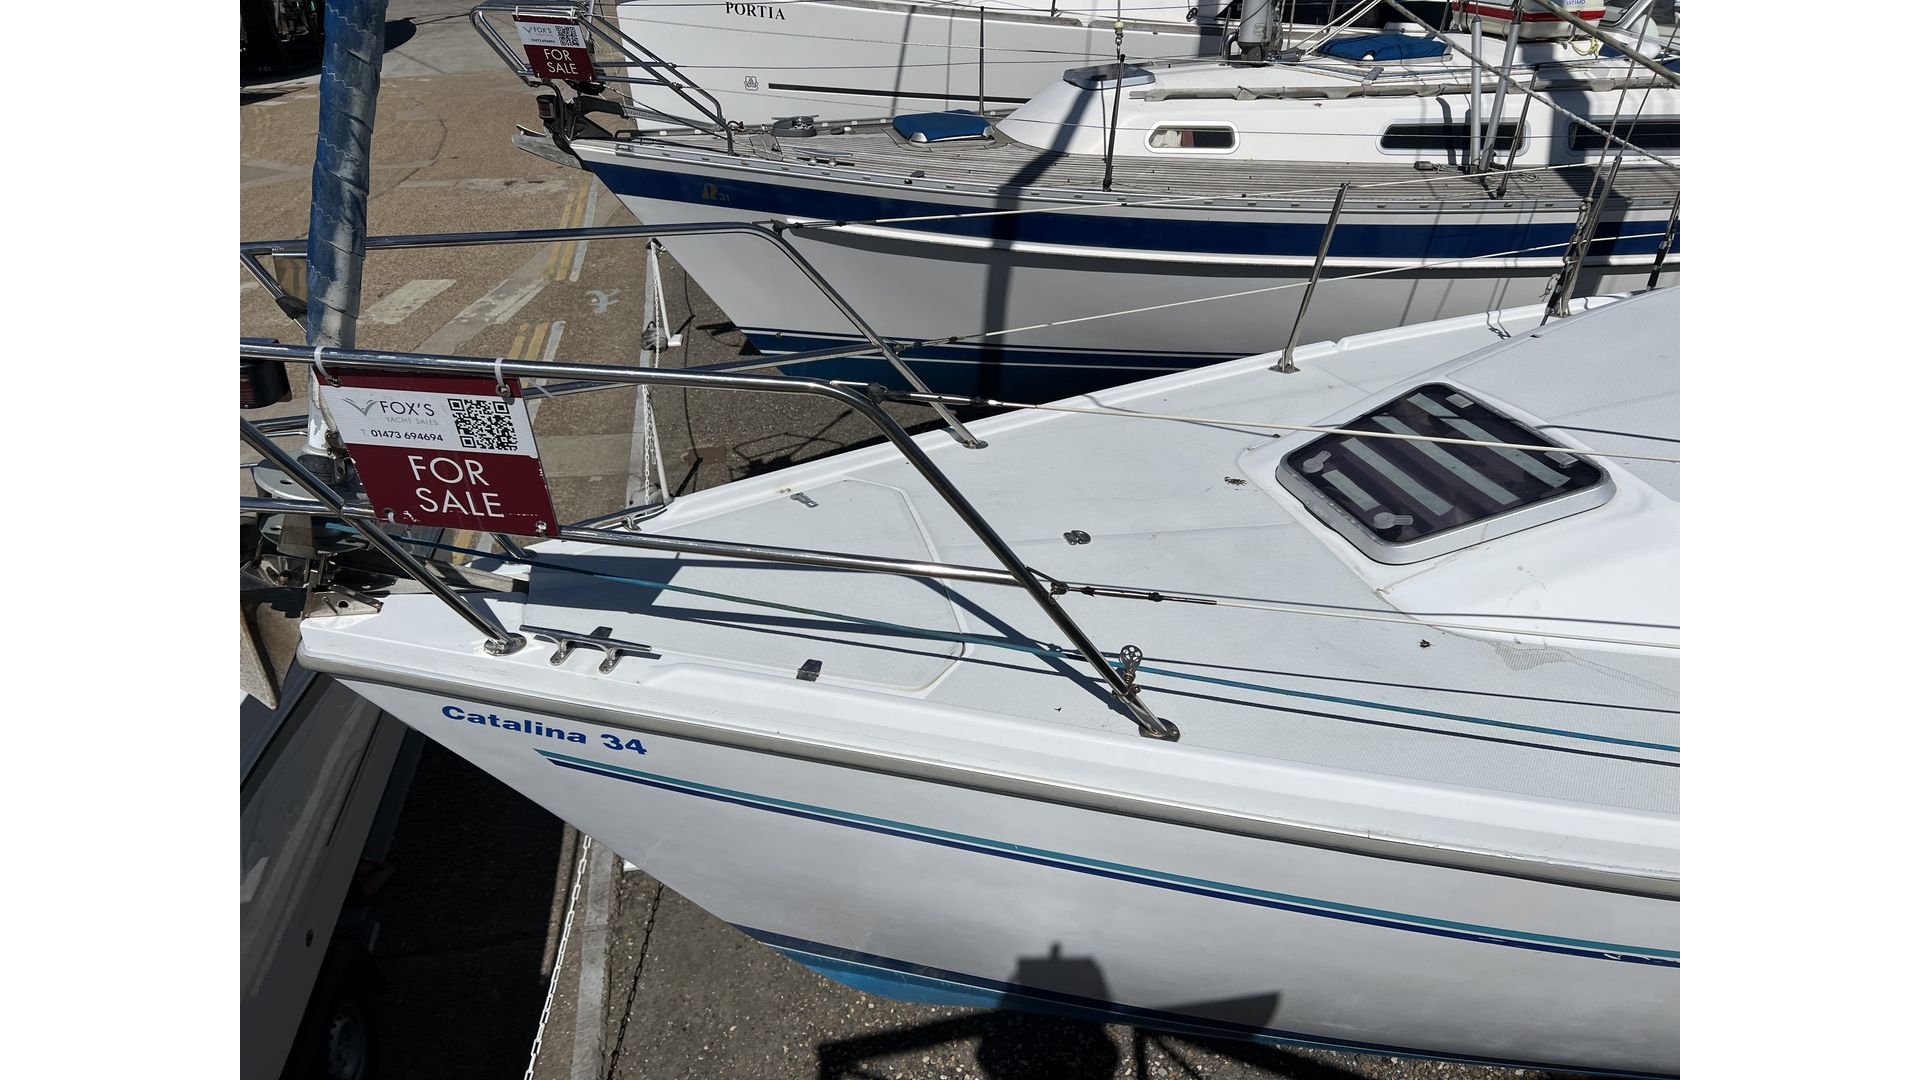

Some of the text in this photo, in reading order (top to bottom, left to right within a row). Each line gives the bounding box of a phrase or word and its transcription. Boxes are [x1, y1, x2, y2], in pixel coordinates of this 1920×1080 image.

[726, 2, 785, 20] PORTIA
[544, 48, 572, 61] FOR
[546, 61, 579, 75] SALE
[379, 400, 435, 417] FOX'S
[386, 416, 439, 426] YACHT SALES
[370, 429, 402, 439] 01473
[404, 432, 444, 442] 694694
[407, 455, 490, 486] FOR
[415, 487, 505, 518] SALE
[441, 705, 648, 755] Catalina 34
